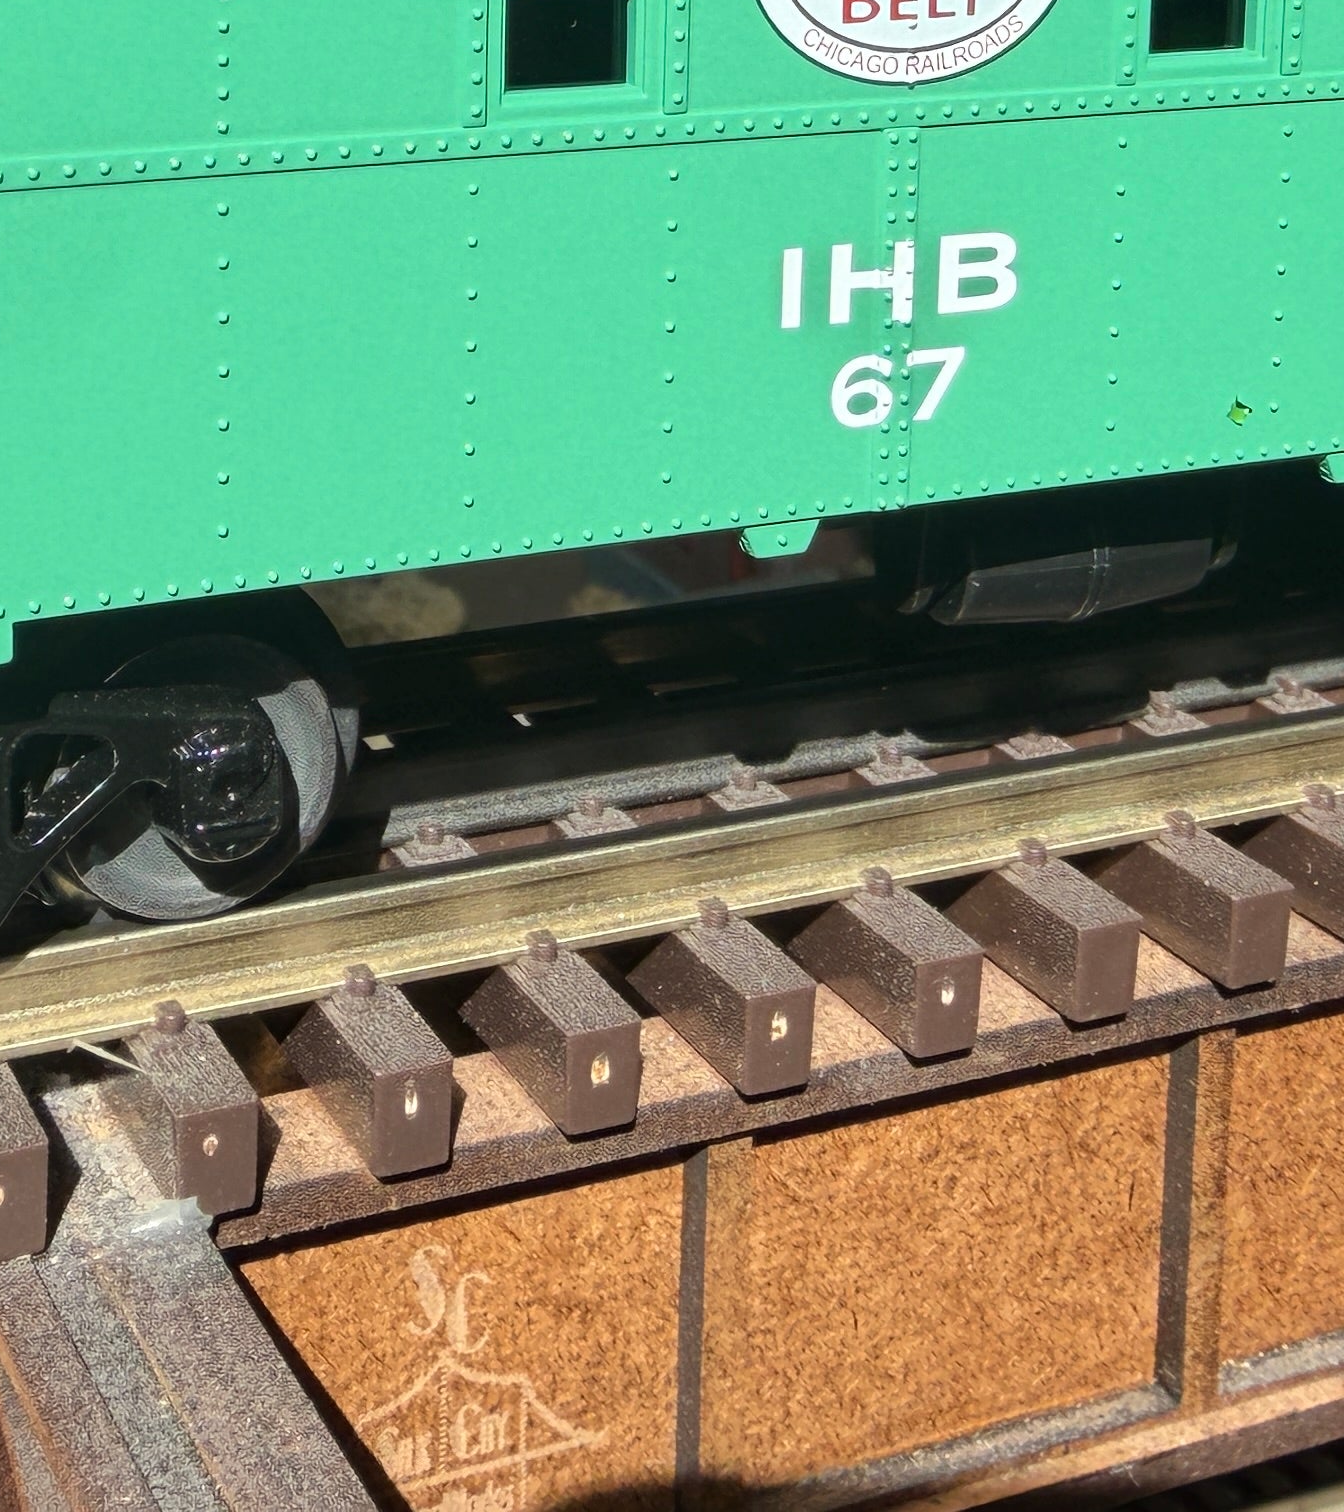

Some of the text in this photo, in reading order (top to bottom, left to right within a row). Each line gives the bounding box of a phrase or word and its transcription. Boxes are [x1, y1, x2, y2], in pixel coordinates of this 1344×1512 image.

[802, 14, 1025, 76] CHICAGO RAILROADS
[780, 231, 1018, 329] IHB
[830, 346, 966, 429] 67
